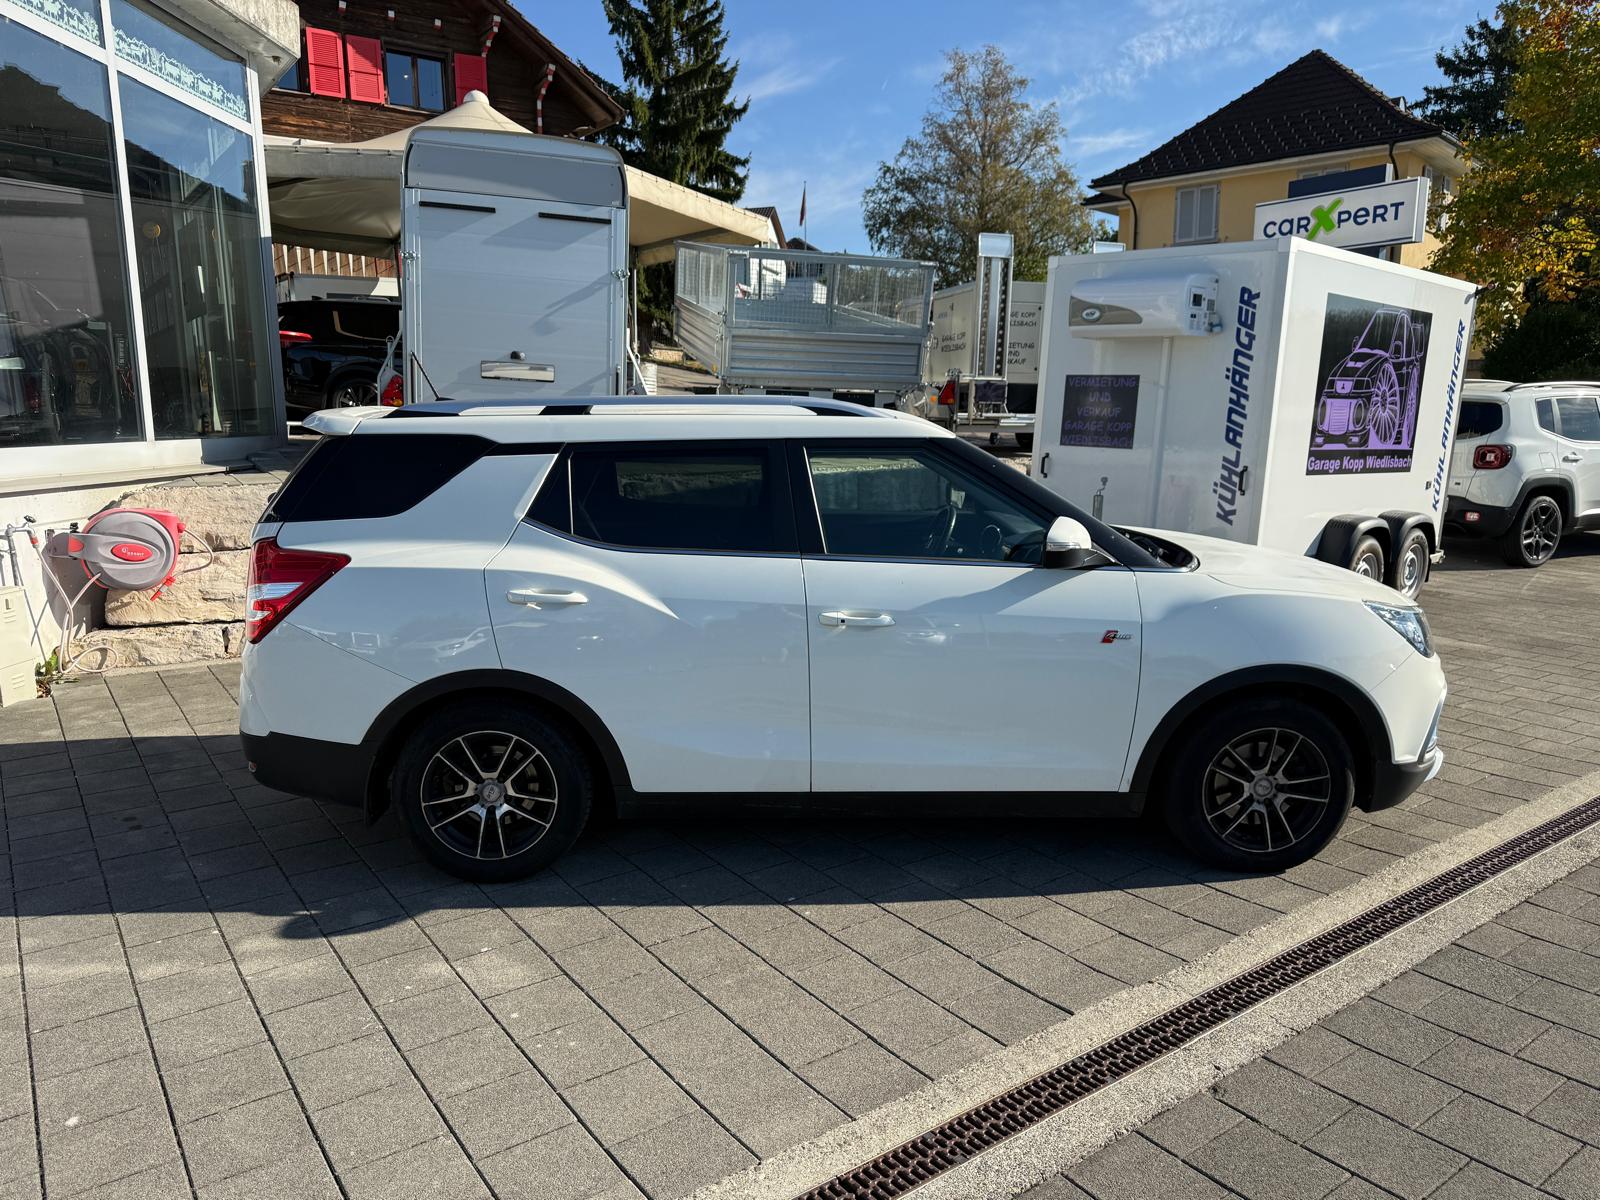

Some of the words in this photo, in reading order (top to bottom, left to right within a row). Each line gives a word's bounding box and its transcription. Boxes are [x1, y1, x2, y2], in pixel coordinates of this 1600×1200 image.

[1068, 376, 1136, 387] VERMIETUNG
[1089, 391, 1111, 402] UND
[1213, 286, 1261, 526] KÜHLANHÄNGER
[1077, 407, 1121, 417] VERKAUF
[1431, 318, 1467, 511] KÜHLANHÄNGER
[1064, 421, 1104, 431] GARAGE
[1107, 422, 1133, 432] KOPP
[1307, 456, 1340, 473] Garage
[1343, 456, 1364, 472] Kopp
[1366, 454, 1412, 469] Wiedlisbach
